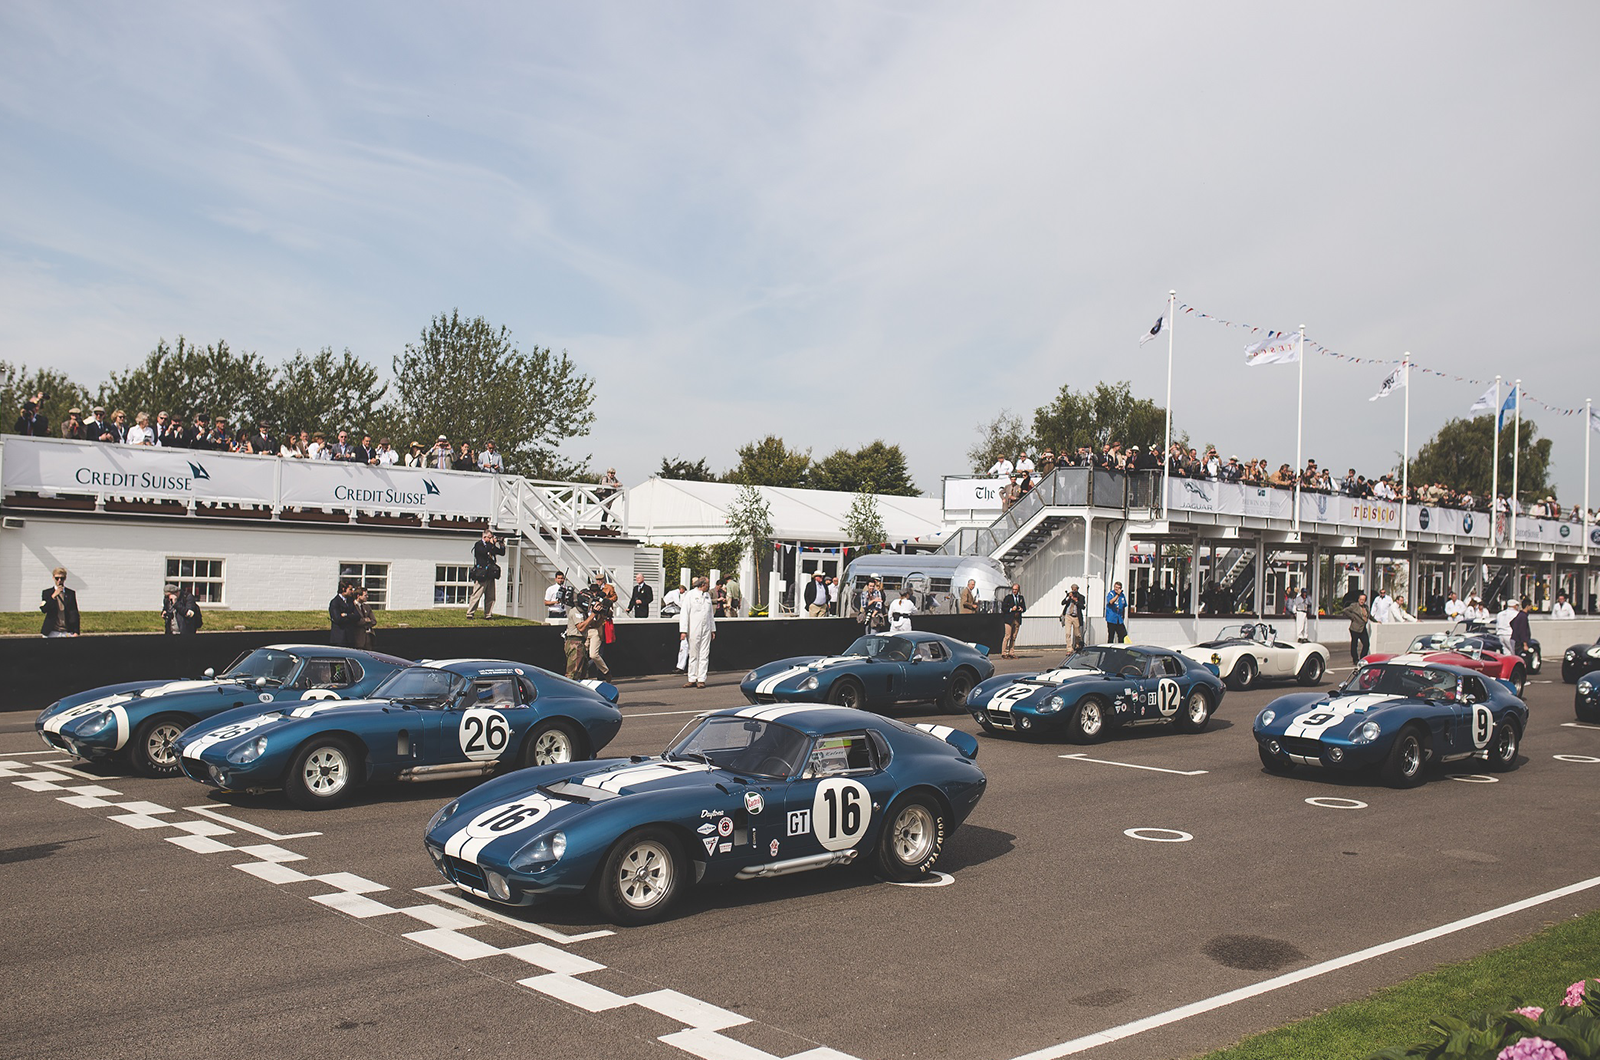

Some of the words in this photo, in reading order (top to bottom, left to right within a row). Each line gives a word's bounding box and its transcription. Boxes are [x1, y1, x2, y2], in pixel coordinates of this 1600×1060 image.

[75, 467, 139, 488] CREDIT
[140, 472, 193, 491] SUISSE
[334, 485, 384, 503] CREDIT
[385, 488, 427, 505] SUISSE
[975, 486, 996, 501] The
[1180, 502, 1213, 511] JAGUAR
[1353, 506, 1395, 521] TESCO
[1294, 532, 1299, 541] 2
[1401, 540, 1406, 548] 4
[1447, 544, 1452, 552] 5
[996, 686, 1032, 700] 12
[1148, 693, 1156, 705] GT
[1160, 682, 1178, 711] 12
[1302, 713, 1335, 726] 9
[1477, 708, 1488, 742] 9
[207, 725, 251, 739] 26
[465, 714, 507, 753] 26
[477, 803, 540, 832] 16
[823, 785, 861, 839] 16
[789, 811, 808, 834] GT
